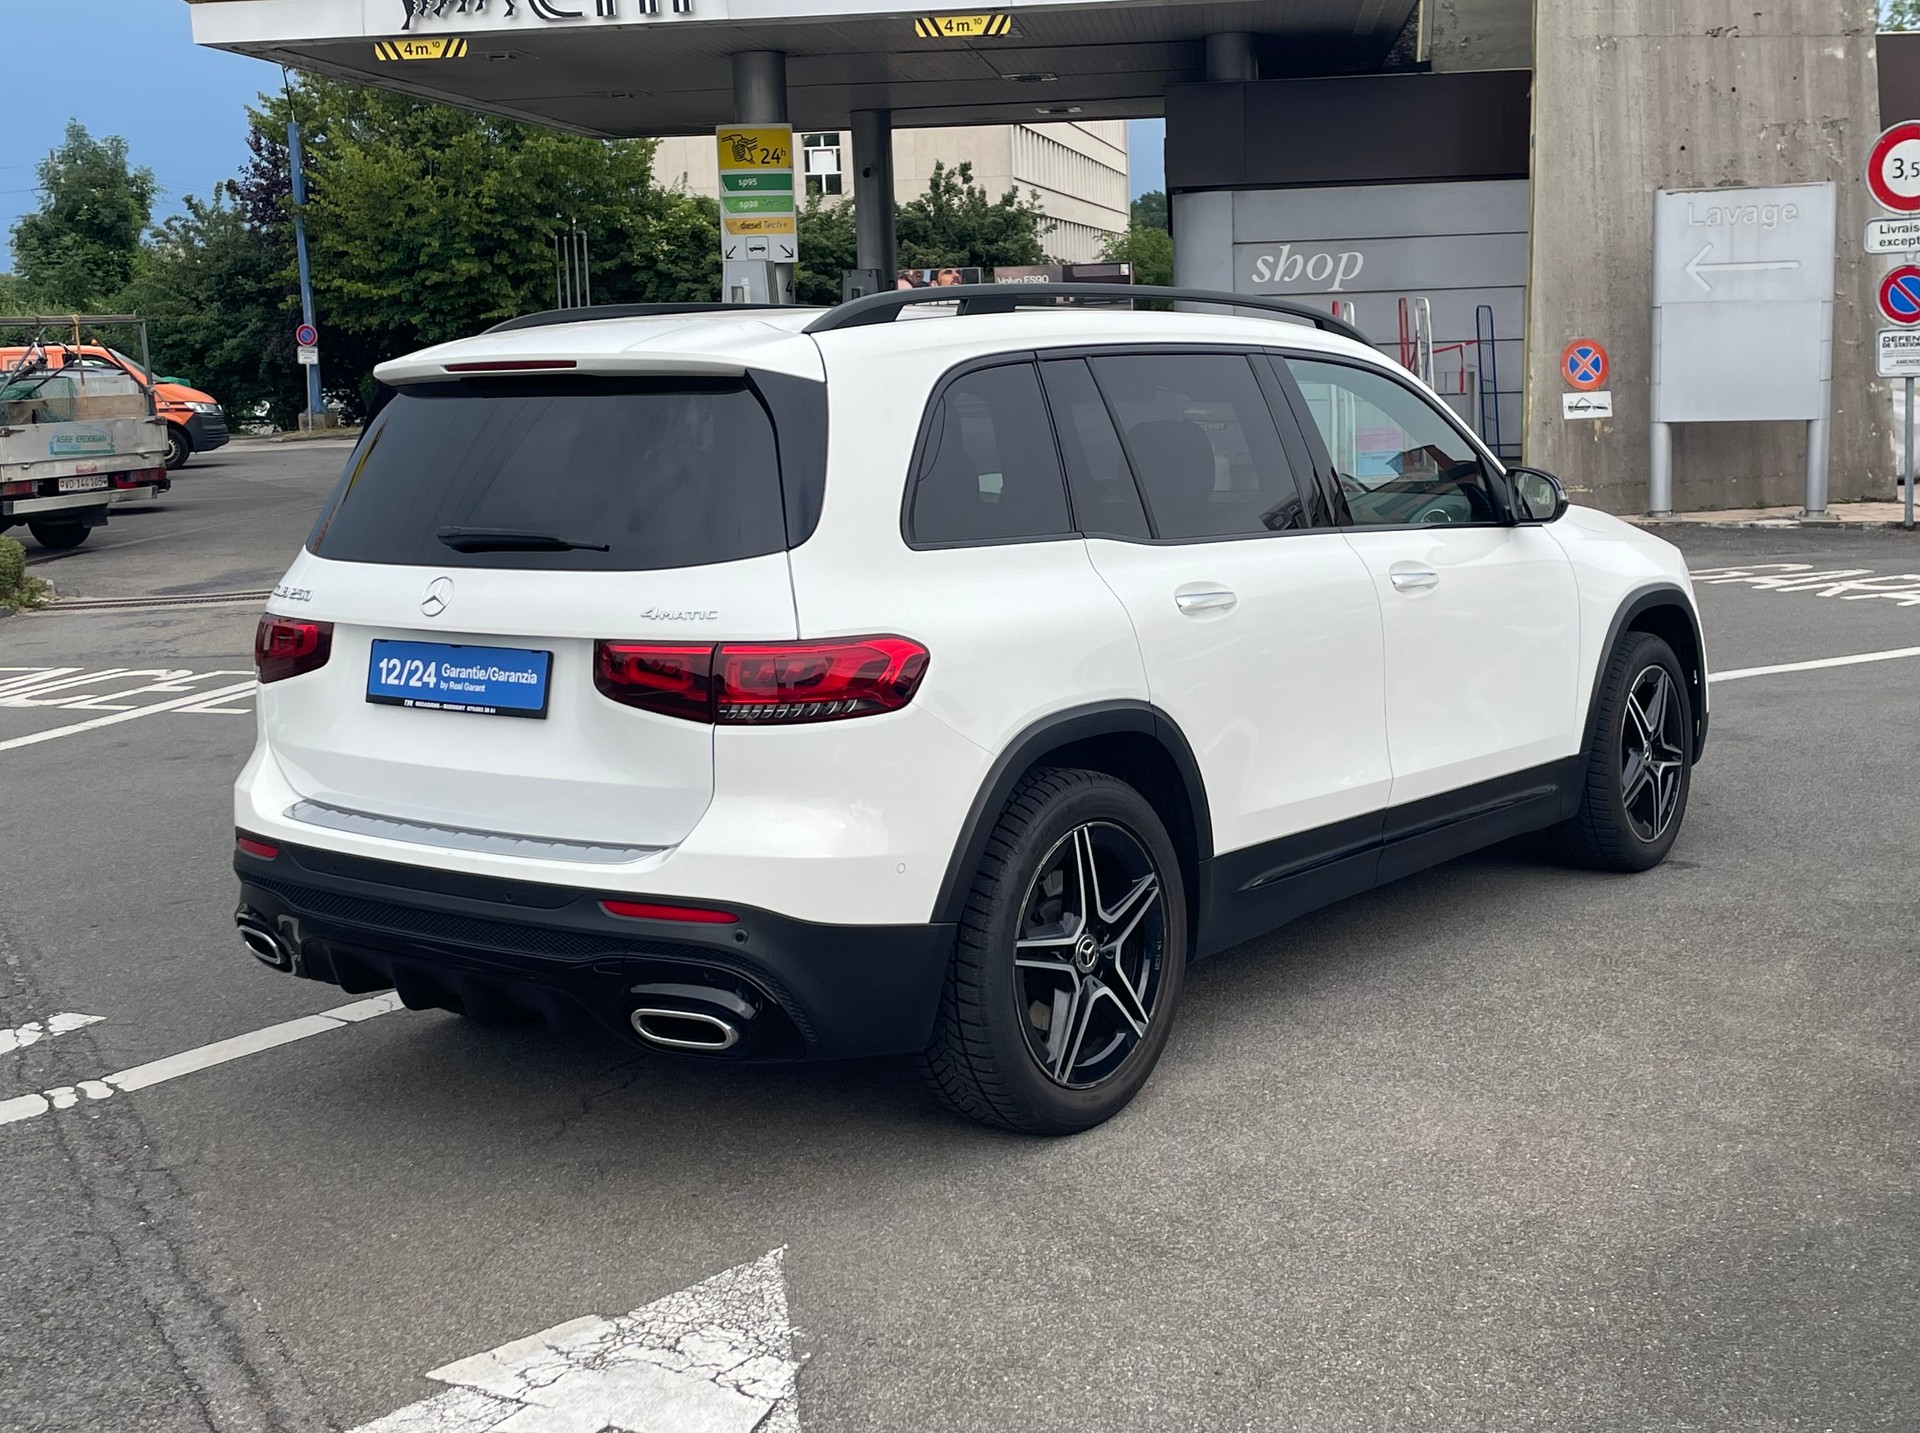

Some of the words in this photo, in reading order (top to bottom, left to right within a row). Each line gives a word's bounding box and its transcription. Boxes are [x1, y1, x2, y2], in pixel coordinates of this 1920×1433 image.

[738, 177, 758, 189] sp95
[739, 201, 759, 211] sp98
[1687, 202, 1799, 231] Lavage
[740, 220, 762, 230] diesel
[1252, 244, 1364, 292] shop
[640, 607, 719, 621] 4MATIC
[379, 658, 437, 689] 12/24
[440, 681, 449, 692] by
[449, 682, 464, 691] Real
[464, 682, 486, 693] Garant
